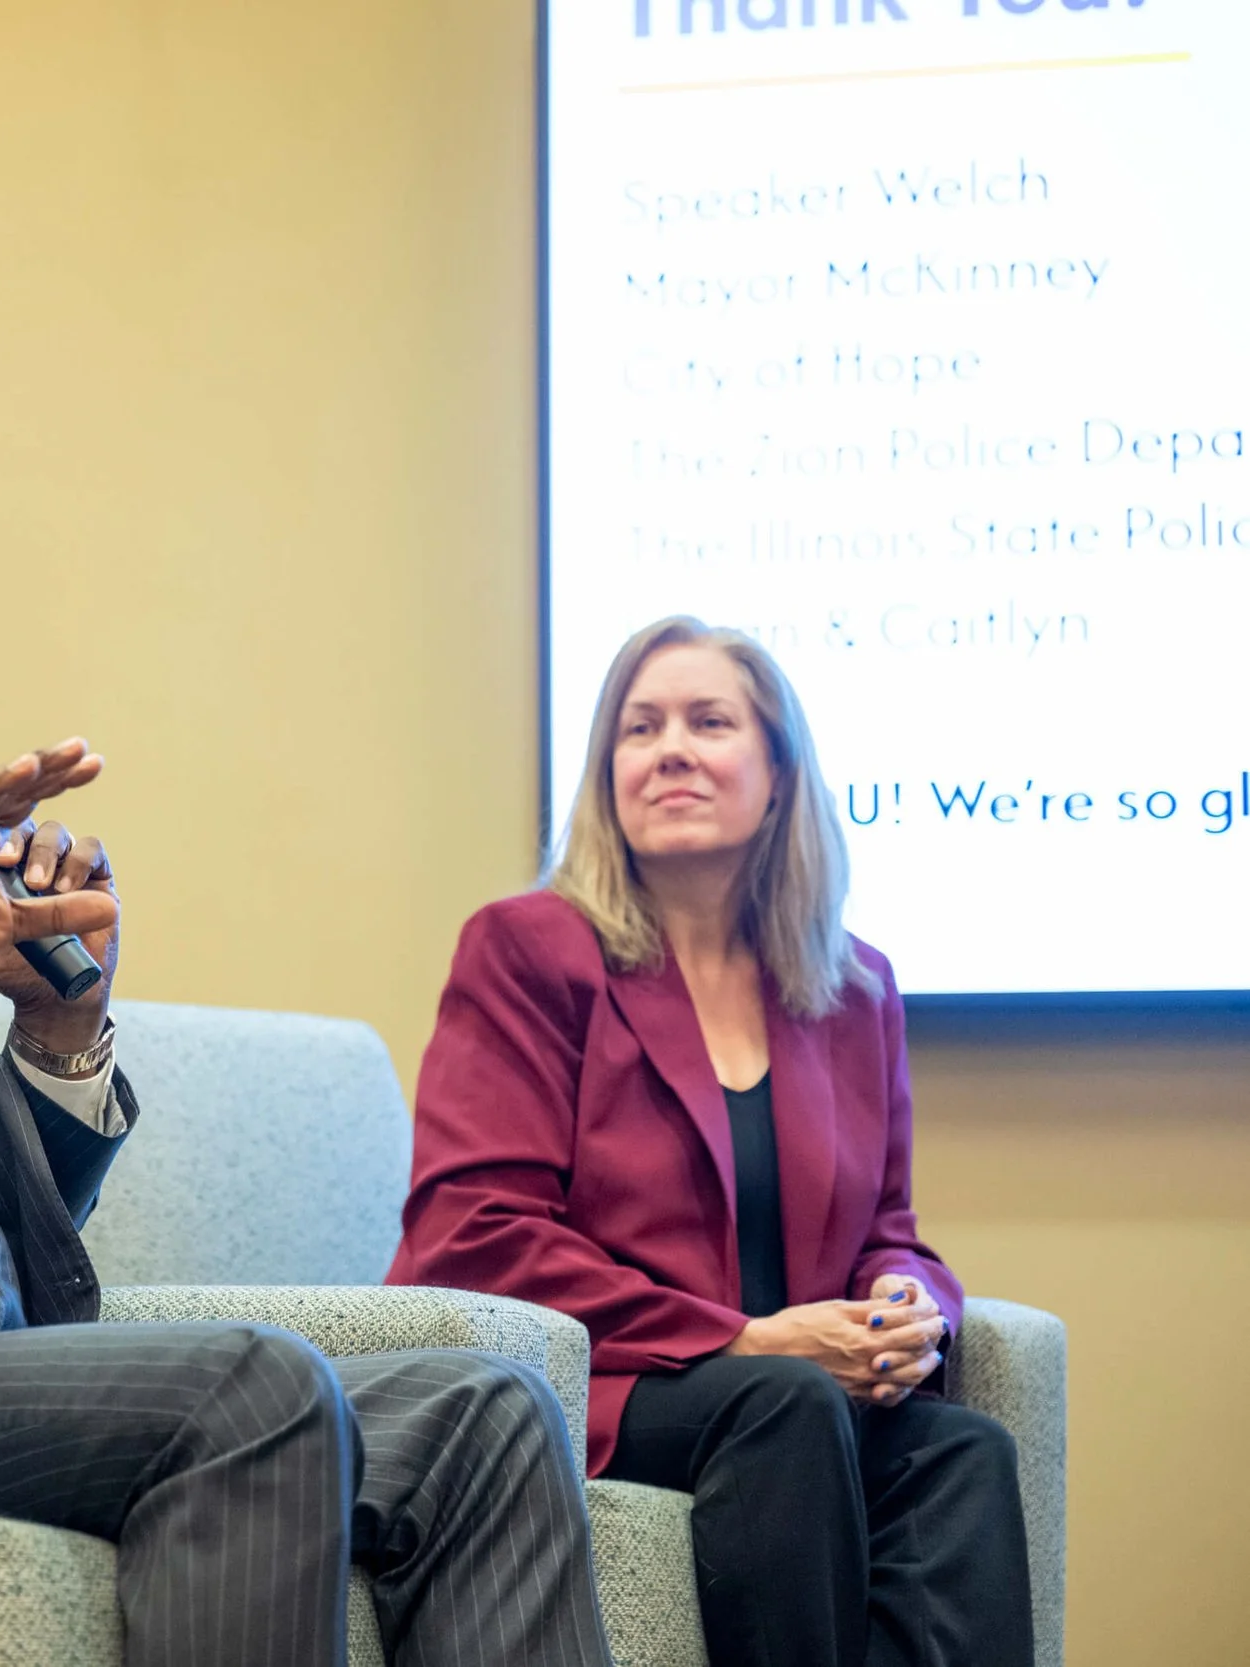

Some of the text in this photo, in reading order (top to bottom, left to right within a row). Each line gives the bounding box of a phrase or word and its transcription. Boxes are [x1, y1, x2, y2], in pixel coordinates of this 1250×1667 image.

[622, 154, 1051, 240] Speaker Welch
[623, 251, 1111, 317] Mayor McKinney
[754, 340, 807, 389] of
[831, 341, 982, 396] Hope
[888, 422, 1058, 471] Police
[1082, 417, 1244, 476] Depa
[750, 518, 927, 564] Illinois
[949, 510, 1101, 558] State
[823, 607, 858, 651] &
[879, 597, 1090, 659] Caitlyn
[1117, 790, 1177, 821] so
[1201, 771, 1250, 834] gl
